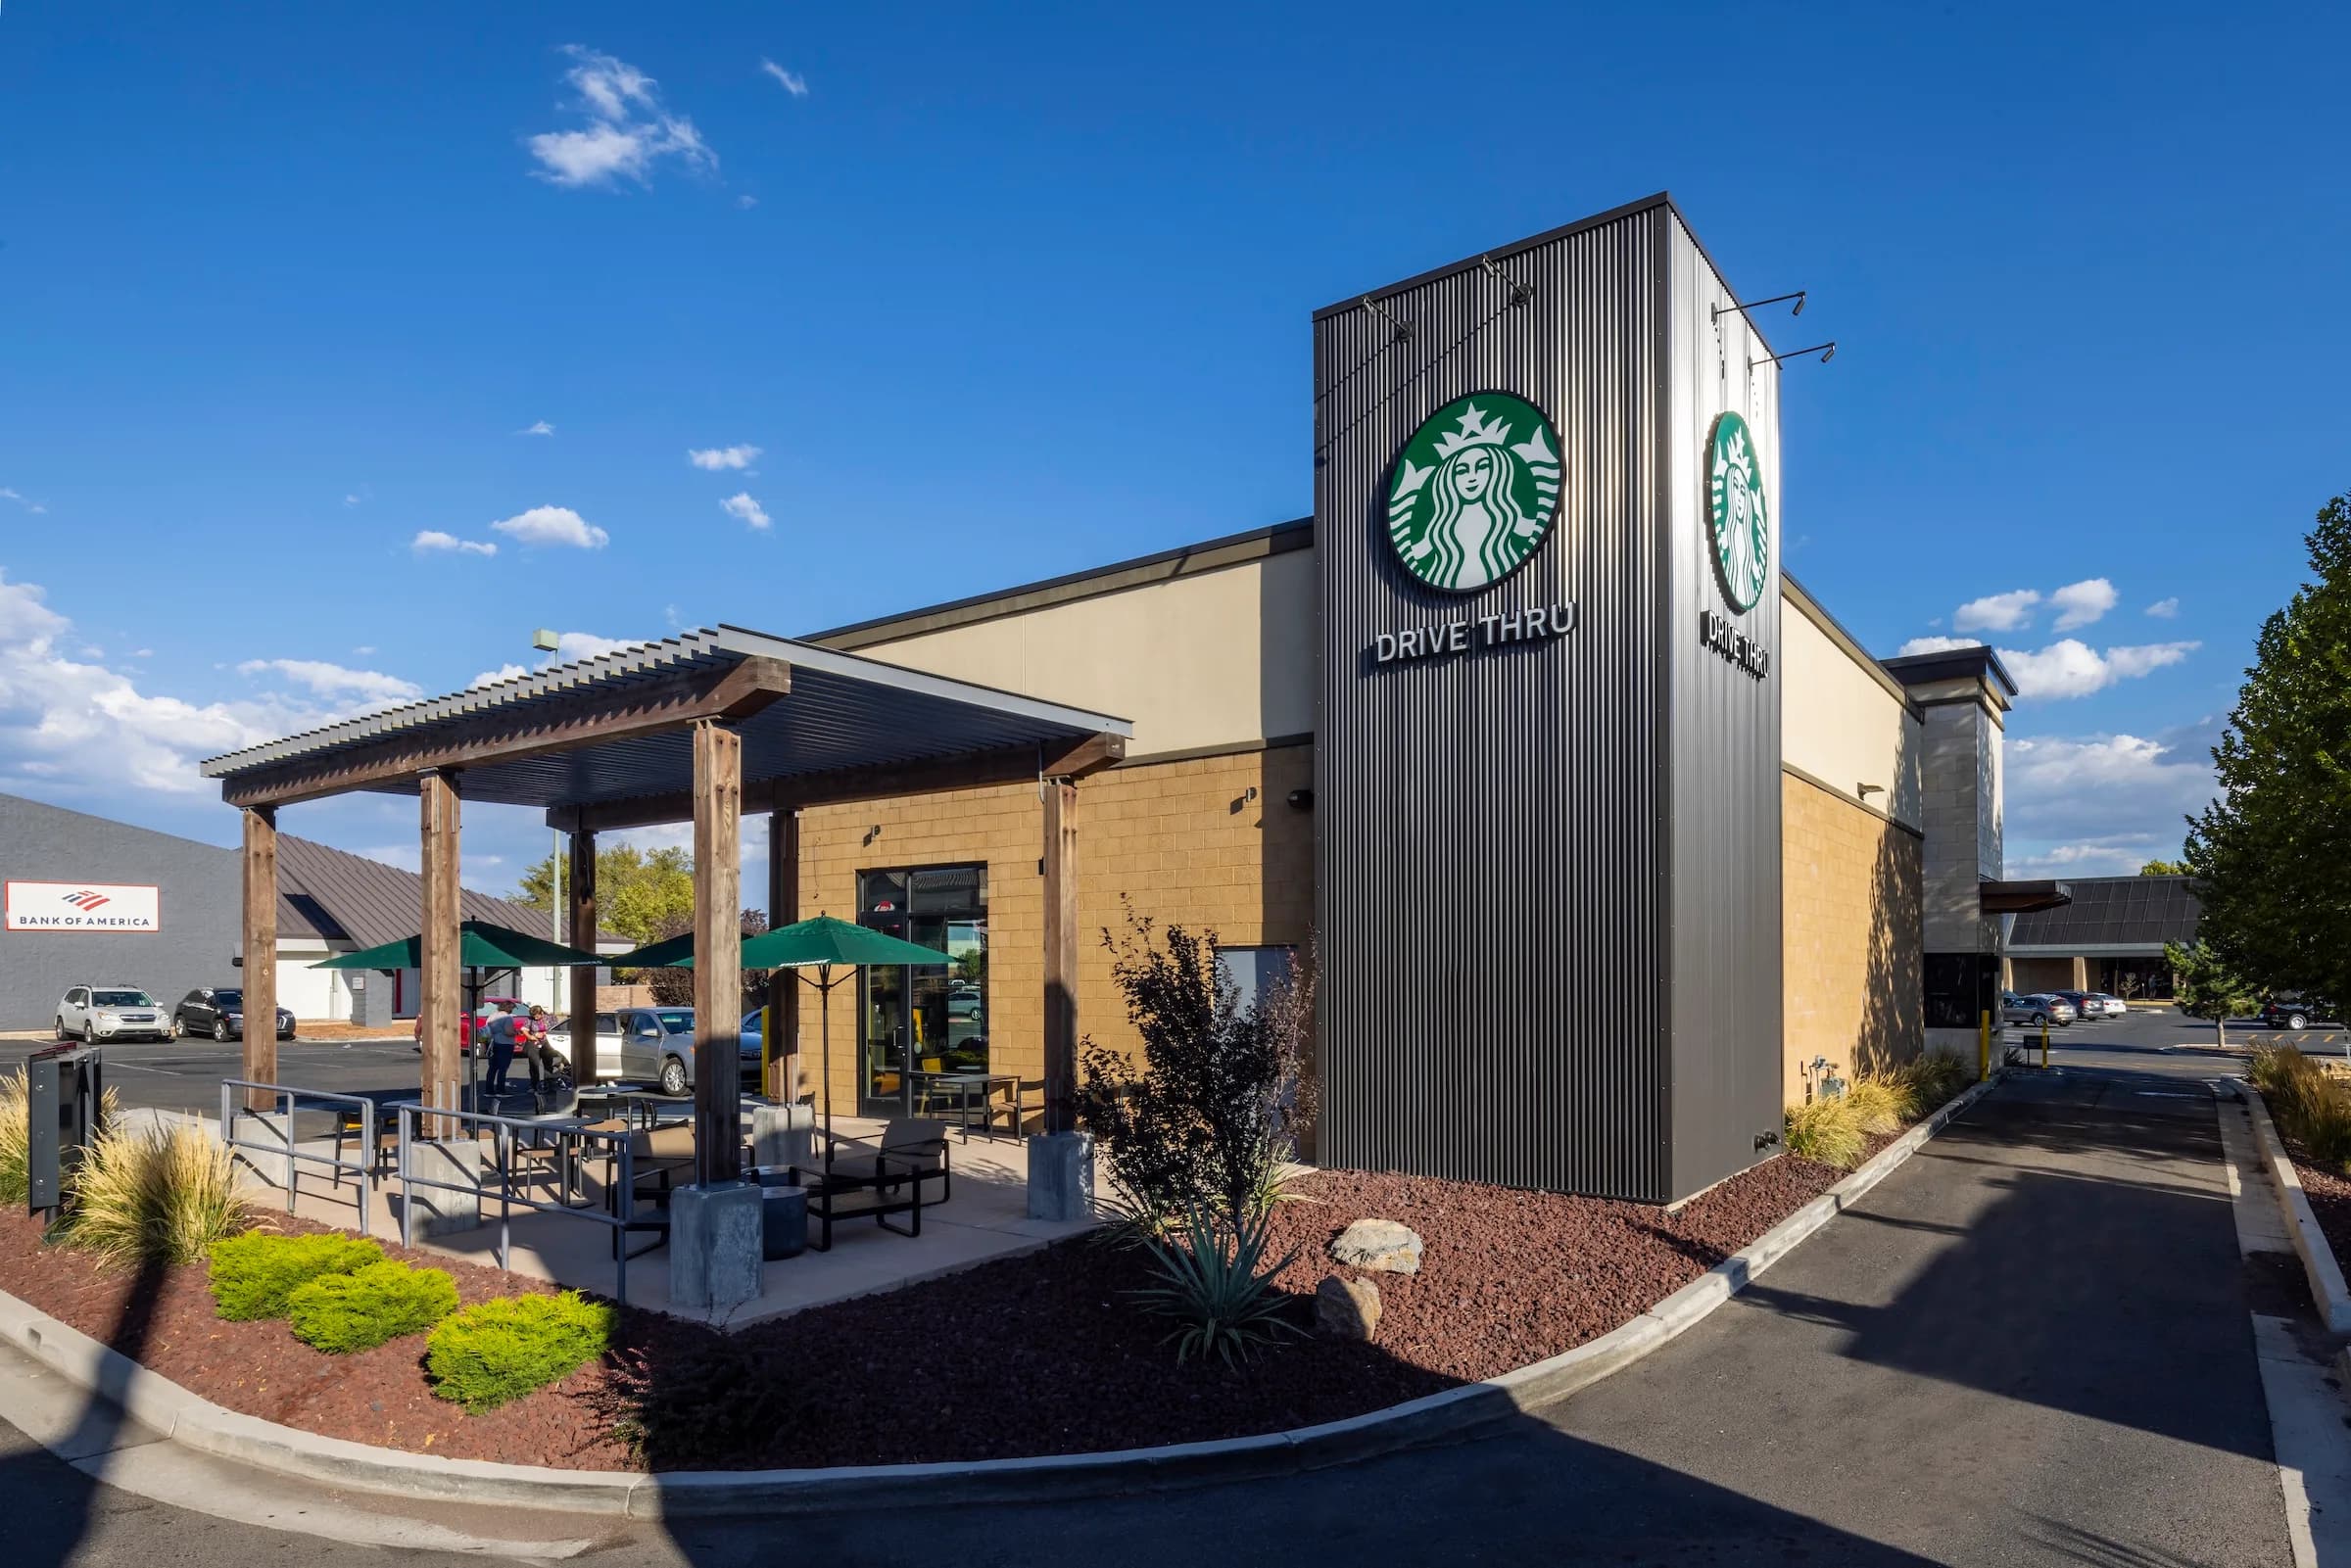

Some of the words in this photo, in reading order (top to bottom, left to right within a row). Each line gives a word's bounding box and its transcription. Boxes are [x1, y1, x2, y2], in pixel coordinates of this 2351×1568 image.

[1377, 620, 1468, 663] DRIVE
[1480, 601, 1576, 645] THRU
[1708, 609, 1741, 659] DRIVE
[1744, 636, 1769, 678] THRU
[20, 916, 61, 925] BANK
[65, 917, 82, 926] OF
[86, 917, 150, 927] AMERICA
